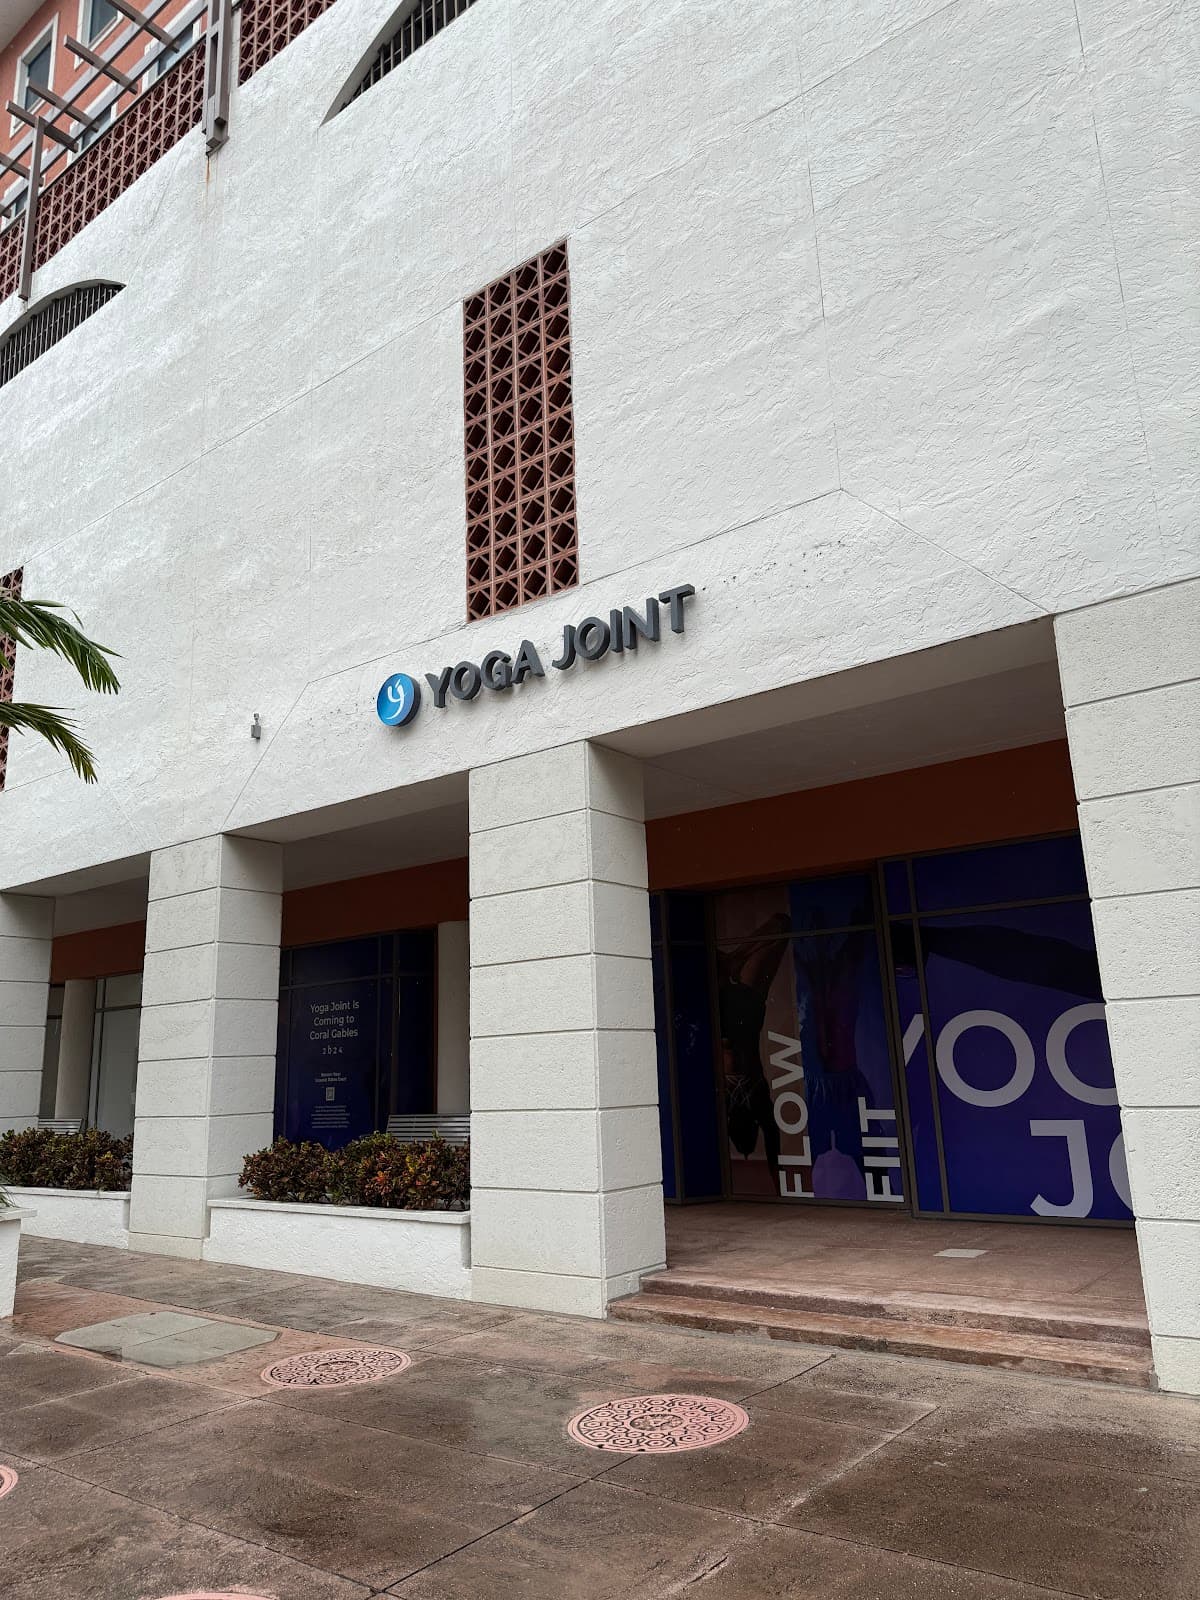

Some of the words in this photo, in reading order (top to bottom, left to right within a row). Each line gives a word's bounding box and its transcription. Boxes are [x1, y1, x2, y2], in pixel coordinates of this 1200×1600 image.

[425, 639, 545, 708] YOGA
[552, 583, 696, 670] JOINT
[310, 1003, 329, 1014] Yoga
[330, 1000, 351, 1011] Joint
[353, 1000, 360, 1009] is
[310, 1029, 329, 1040] Coral
[331, 1027, 358, 1038] Gables
[314, 1016, 344, 1026] Coming
[346, 1015, 355, 1024] to
[768, 1030, 815, 1198] FLOW
[858, 1096, 905, 1203] FIIT
